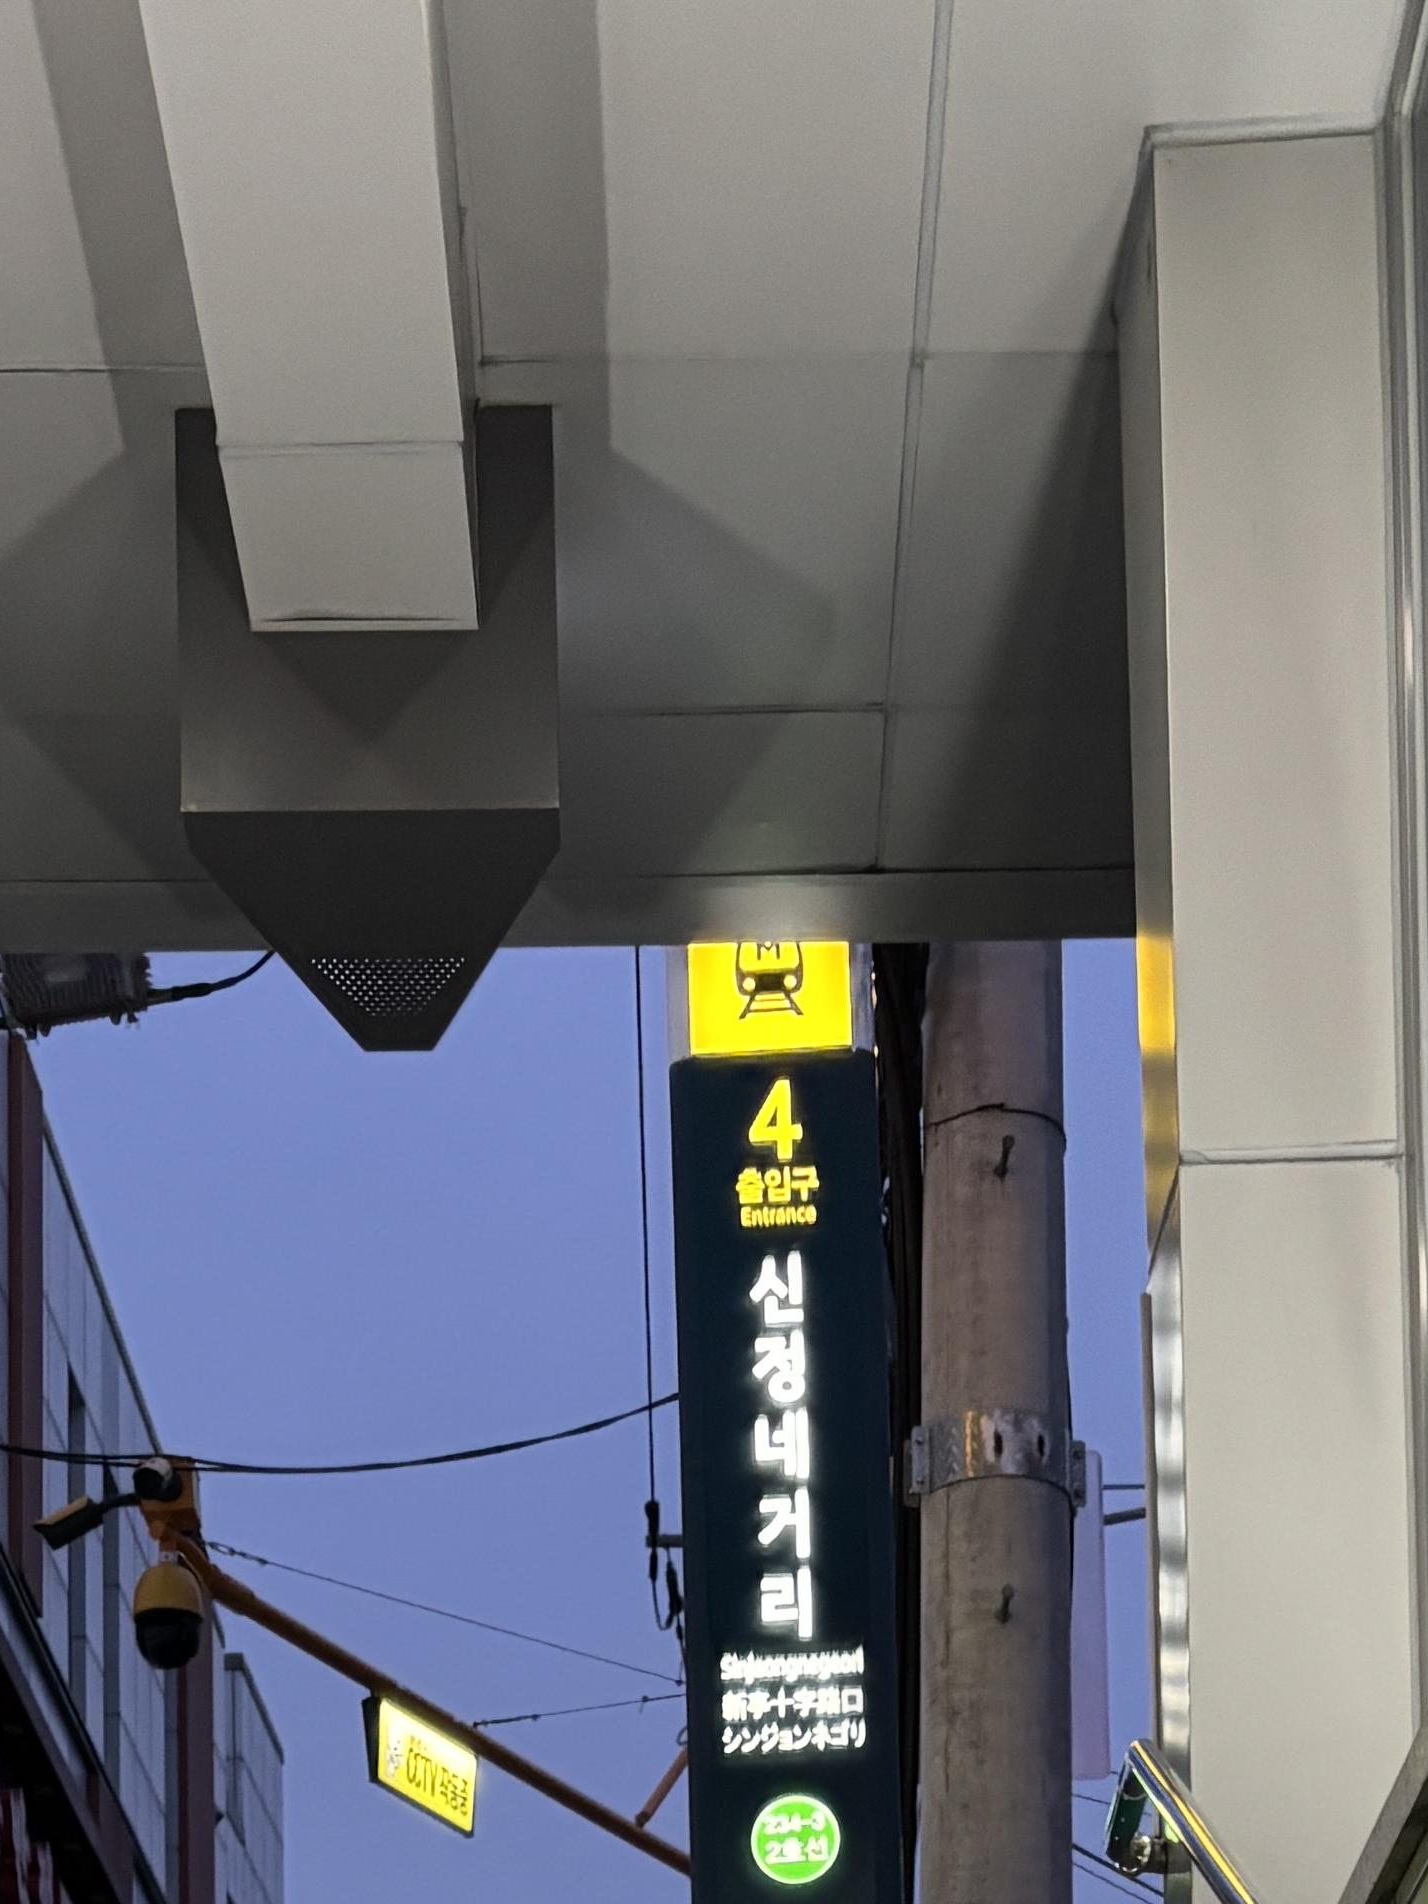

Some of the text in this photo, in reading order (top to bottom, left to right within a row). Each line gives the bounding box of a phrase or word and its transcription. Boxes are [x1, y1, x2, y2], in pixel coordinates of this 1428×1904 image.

[749, 1077, 803, 1160] 4
[736, 1166, 819, 1204] 출입구
[740, 1204, 818, 1228] Entrance
[749, 1250, 812, 1641] 신정네거리
[763, 1811, 825, 1835] 234-3
[764, 1834, 829, 1865] 2호선
